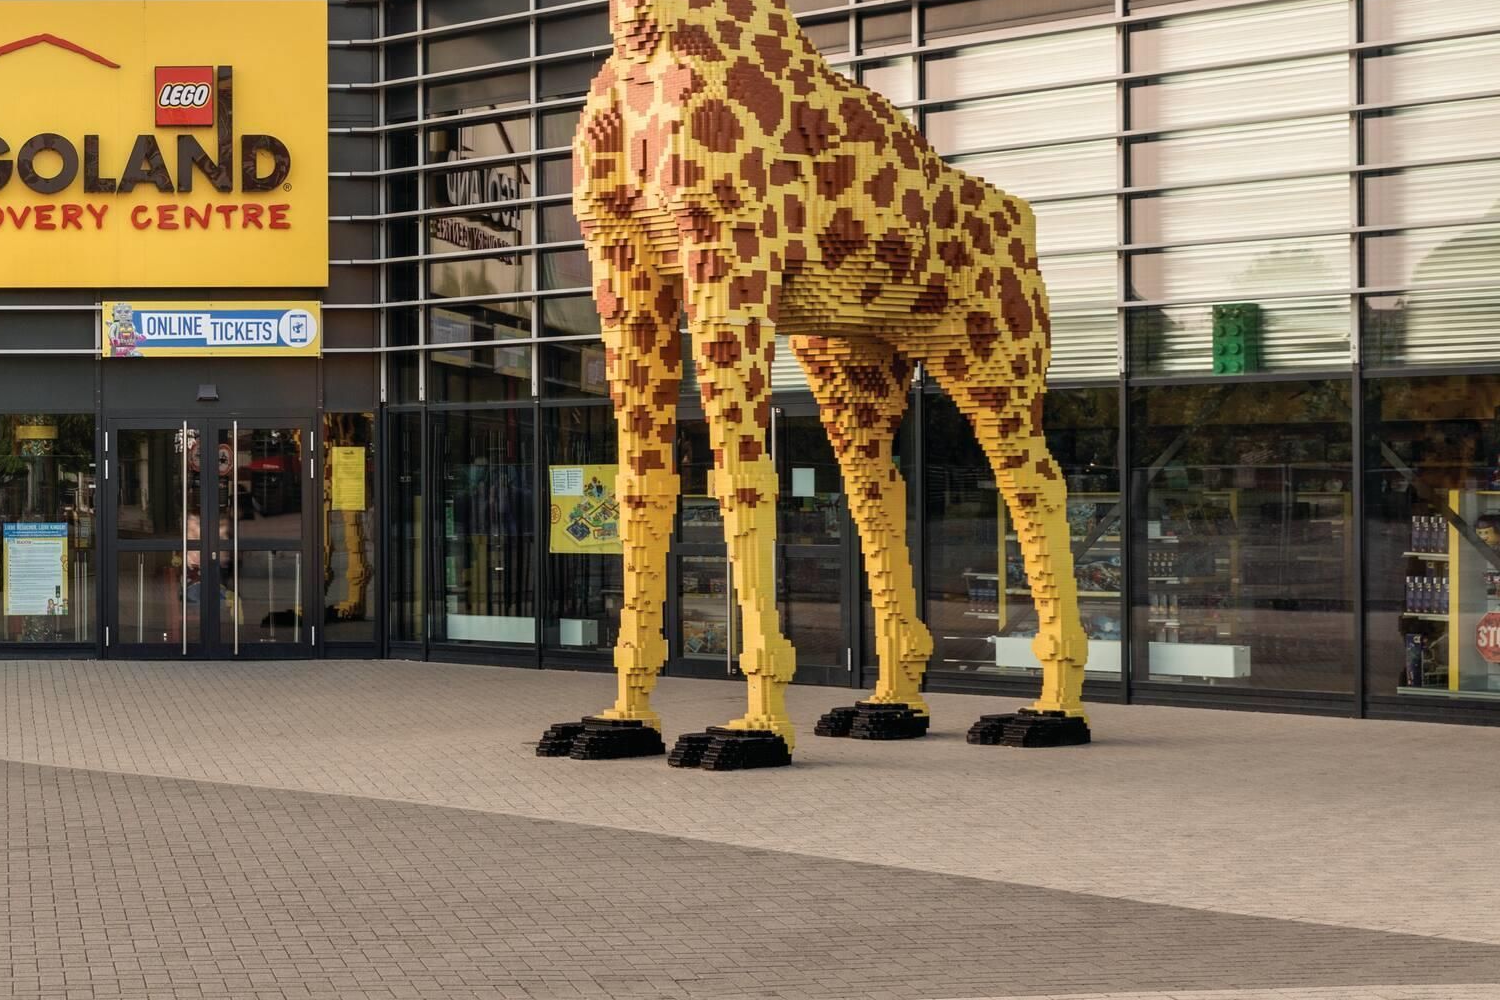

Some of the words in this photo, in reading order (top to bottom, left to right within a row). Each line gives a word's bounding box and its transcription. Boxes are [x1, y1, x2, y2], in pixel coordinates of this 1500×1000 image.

[159, 83, 210, 107] LEGO
[131, 203, 291, 231] CENTRE
[146, 316, 203, 336] ONLINE
[210, 321, 272, 341] TICKETS
